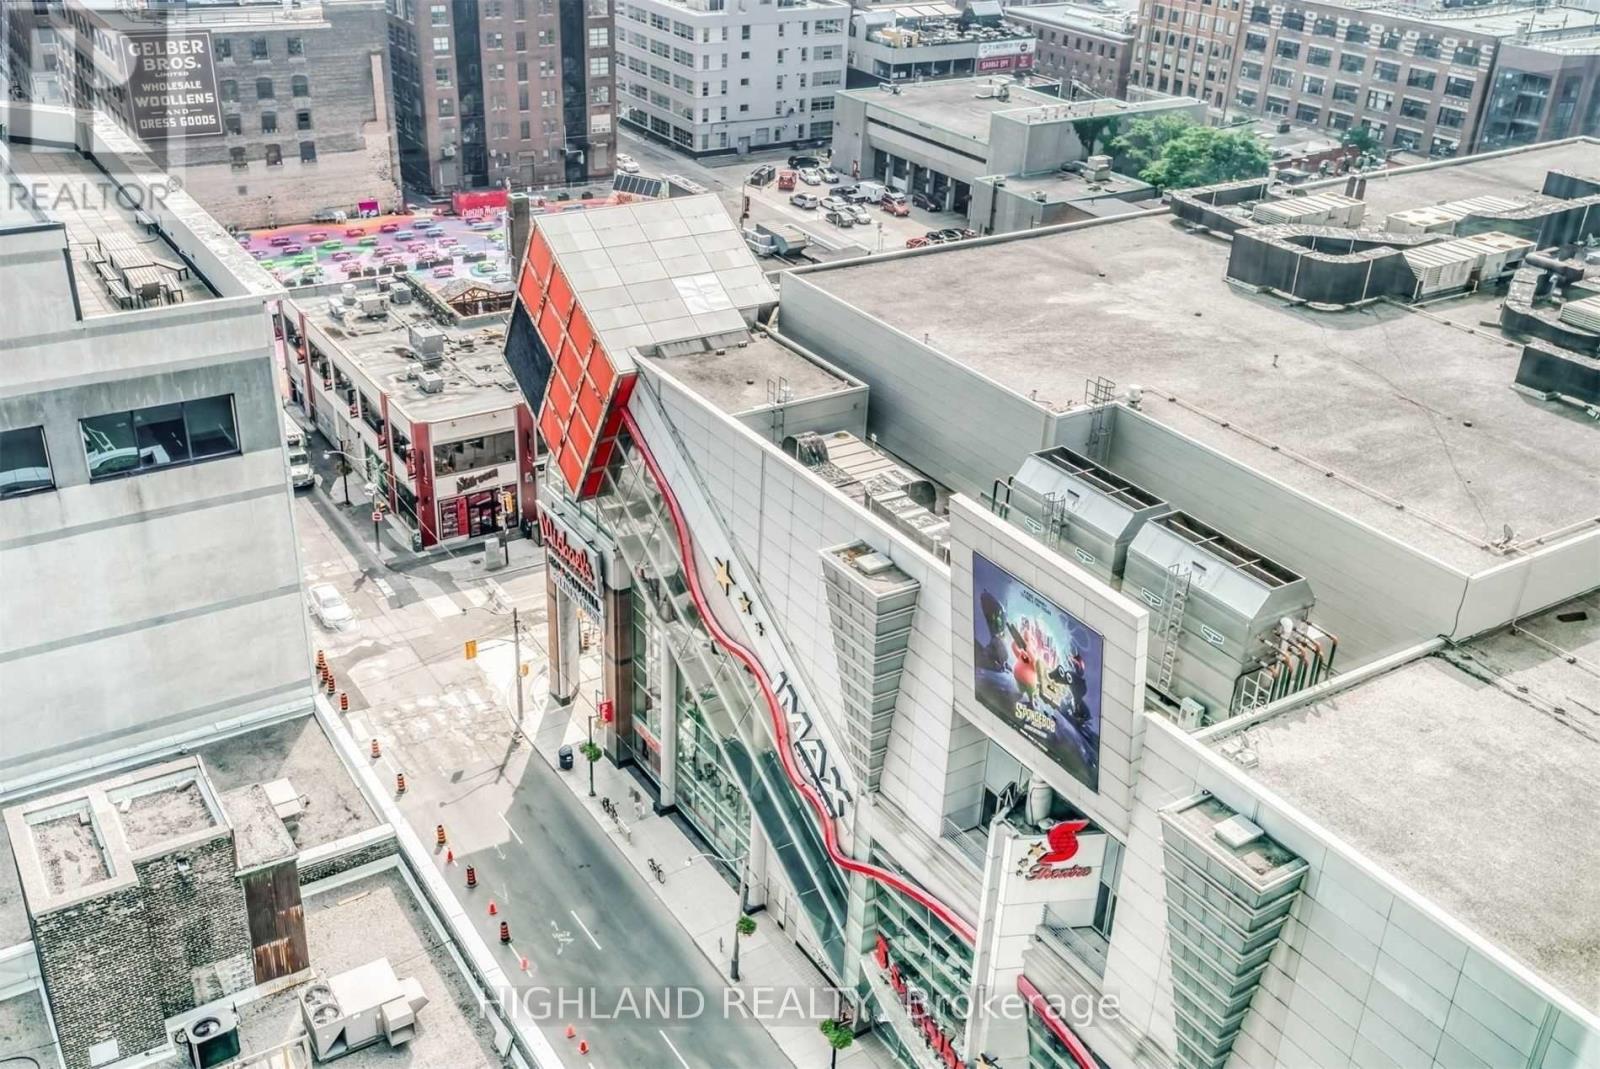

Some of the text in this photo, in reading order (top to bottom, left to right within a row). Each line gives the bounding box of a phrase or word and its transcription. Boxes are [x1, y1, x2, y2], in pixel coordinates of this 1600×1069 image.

[128, 40, 204, 57] GELBER
[143, 56, 202, 71] BROS.
[142, 80, 202, 92] WHOLESALE
[135, 92, 215, 108] WOOLLENS
[140, 114, 217, 130] DRESS GOODS
[771, 671, 853, 818] IMAX
